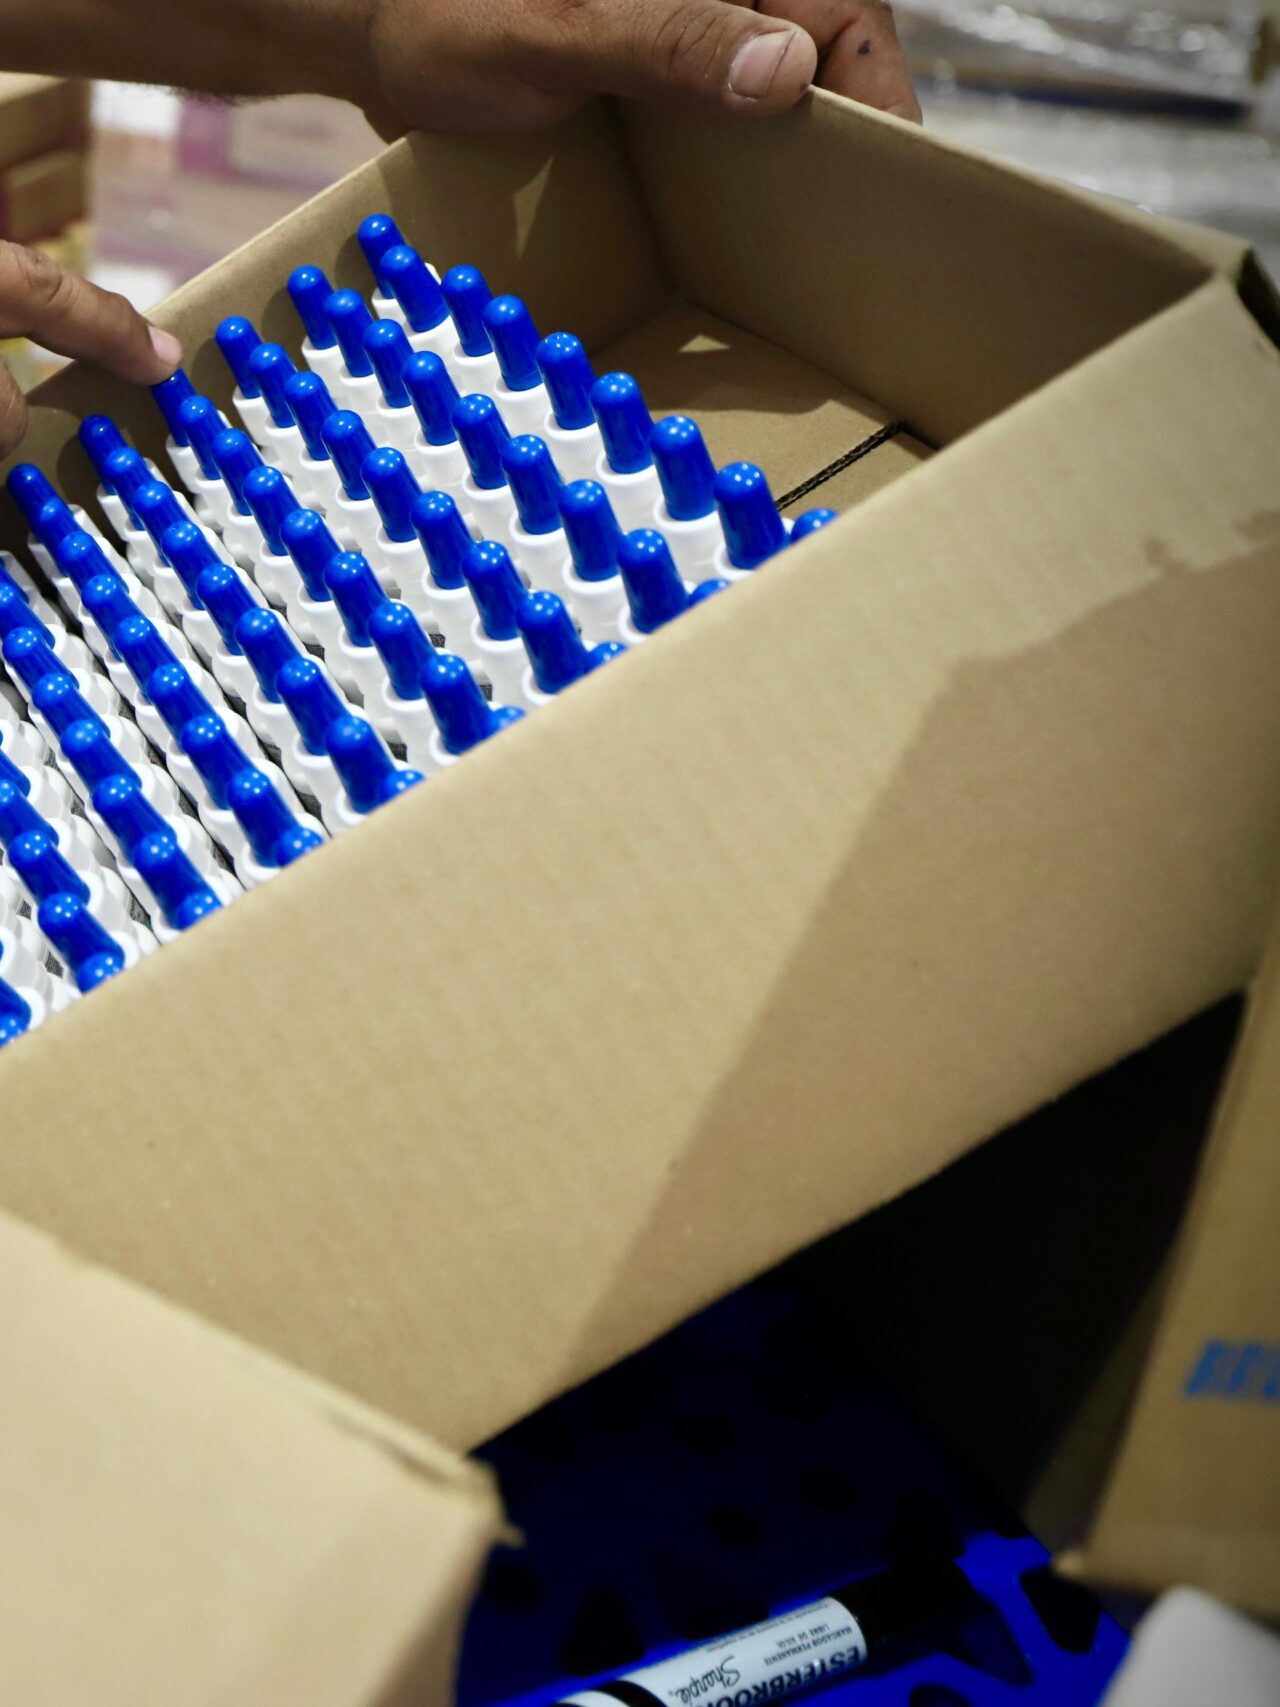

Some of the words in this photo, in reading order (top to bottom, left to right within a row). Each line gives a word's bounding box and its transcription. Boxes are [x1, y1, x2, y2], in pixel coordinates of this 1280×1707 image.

[675, 1654, 741, 1706] Sharpie
[696, 1645, 860, 1707] ESTERBROO
[764, 1642, 813, 1667] PERMANENTE
